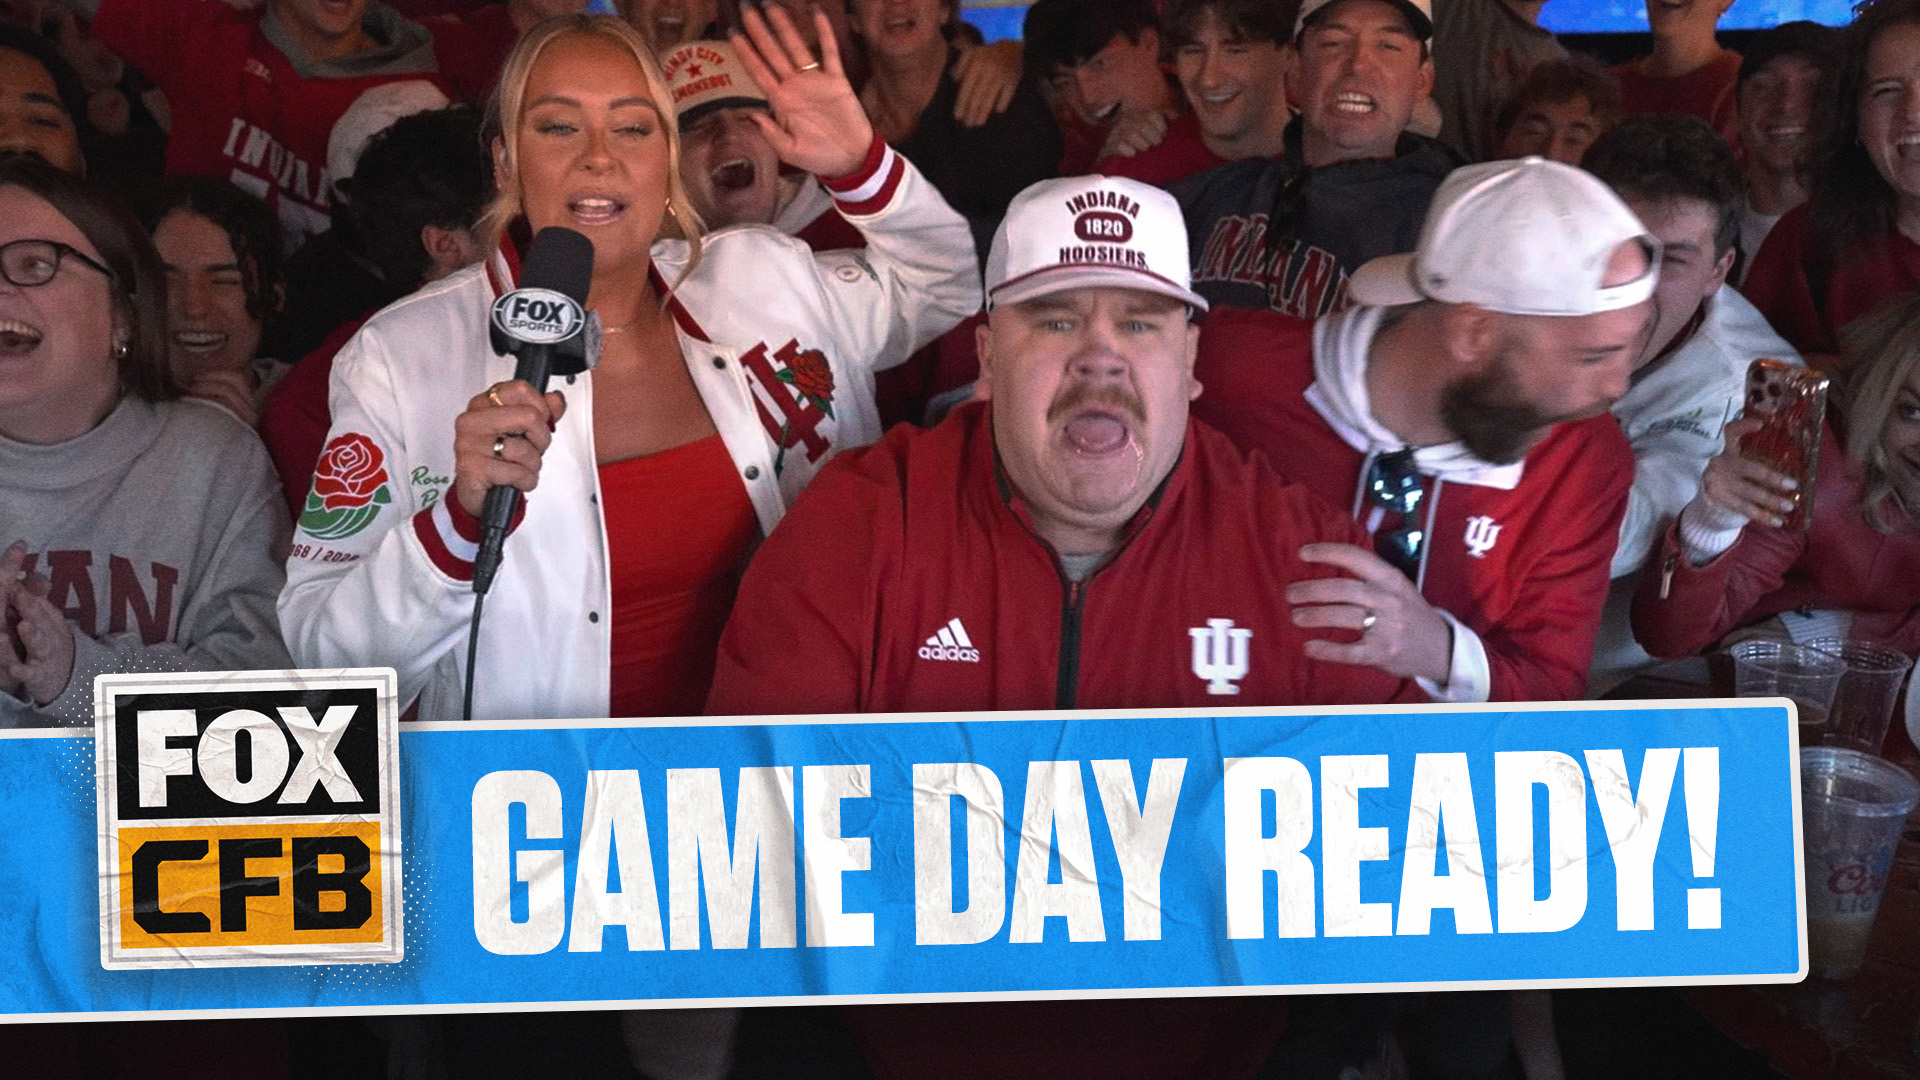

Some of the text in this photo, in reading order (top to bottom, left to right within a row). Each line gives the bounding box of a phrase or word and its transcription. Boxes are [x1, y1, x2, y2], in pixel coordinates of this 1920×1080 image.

[1065, 190, 1141, 220] INDIANA
[1084, 217, 1124, 238] 1820
[1059, 246, 1147, 268] HOOSIERS
[511, 297, 567, 324] FOX
[509, 319, 564, 335] SPORTS
[411, 465, 449, 486] Rose
[918, 645, 980, 663] adidas
